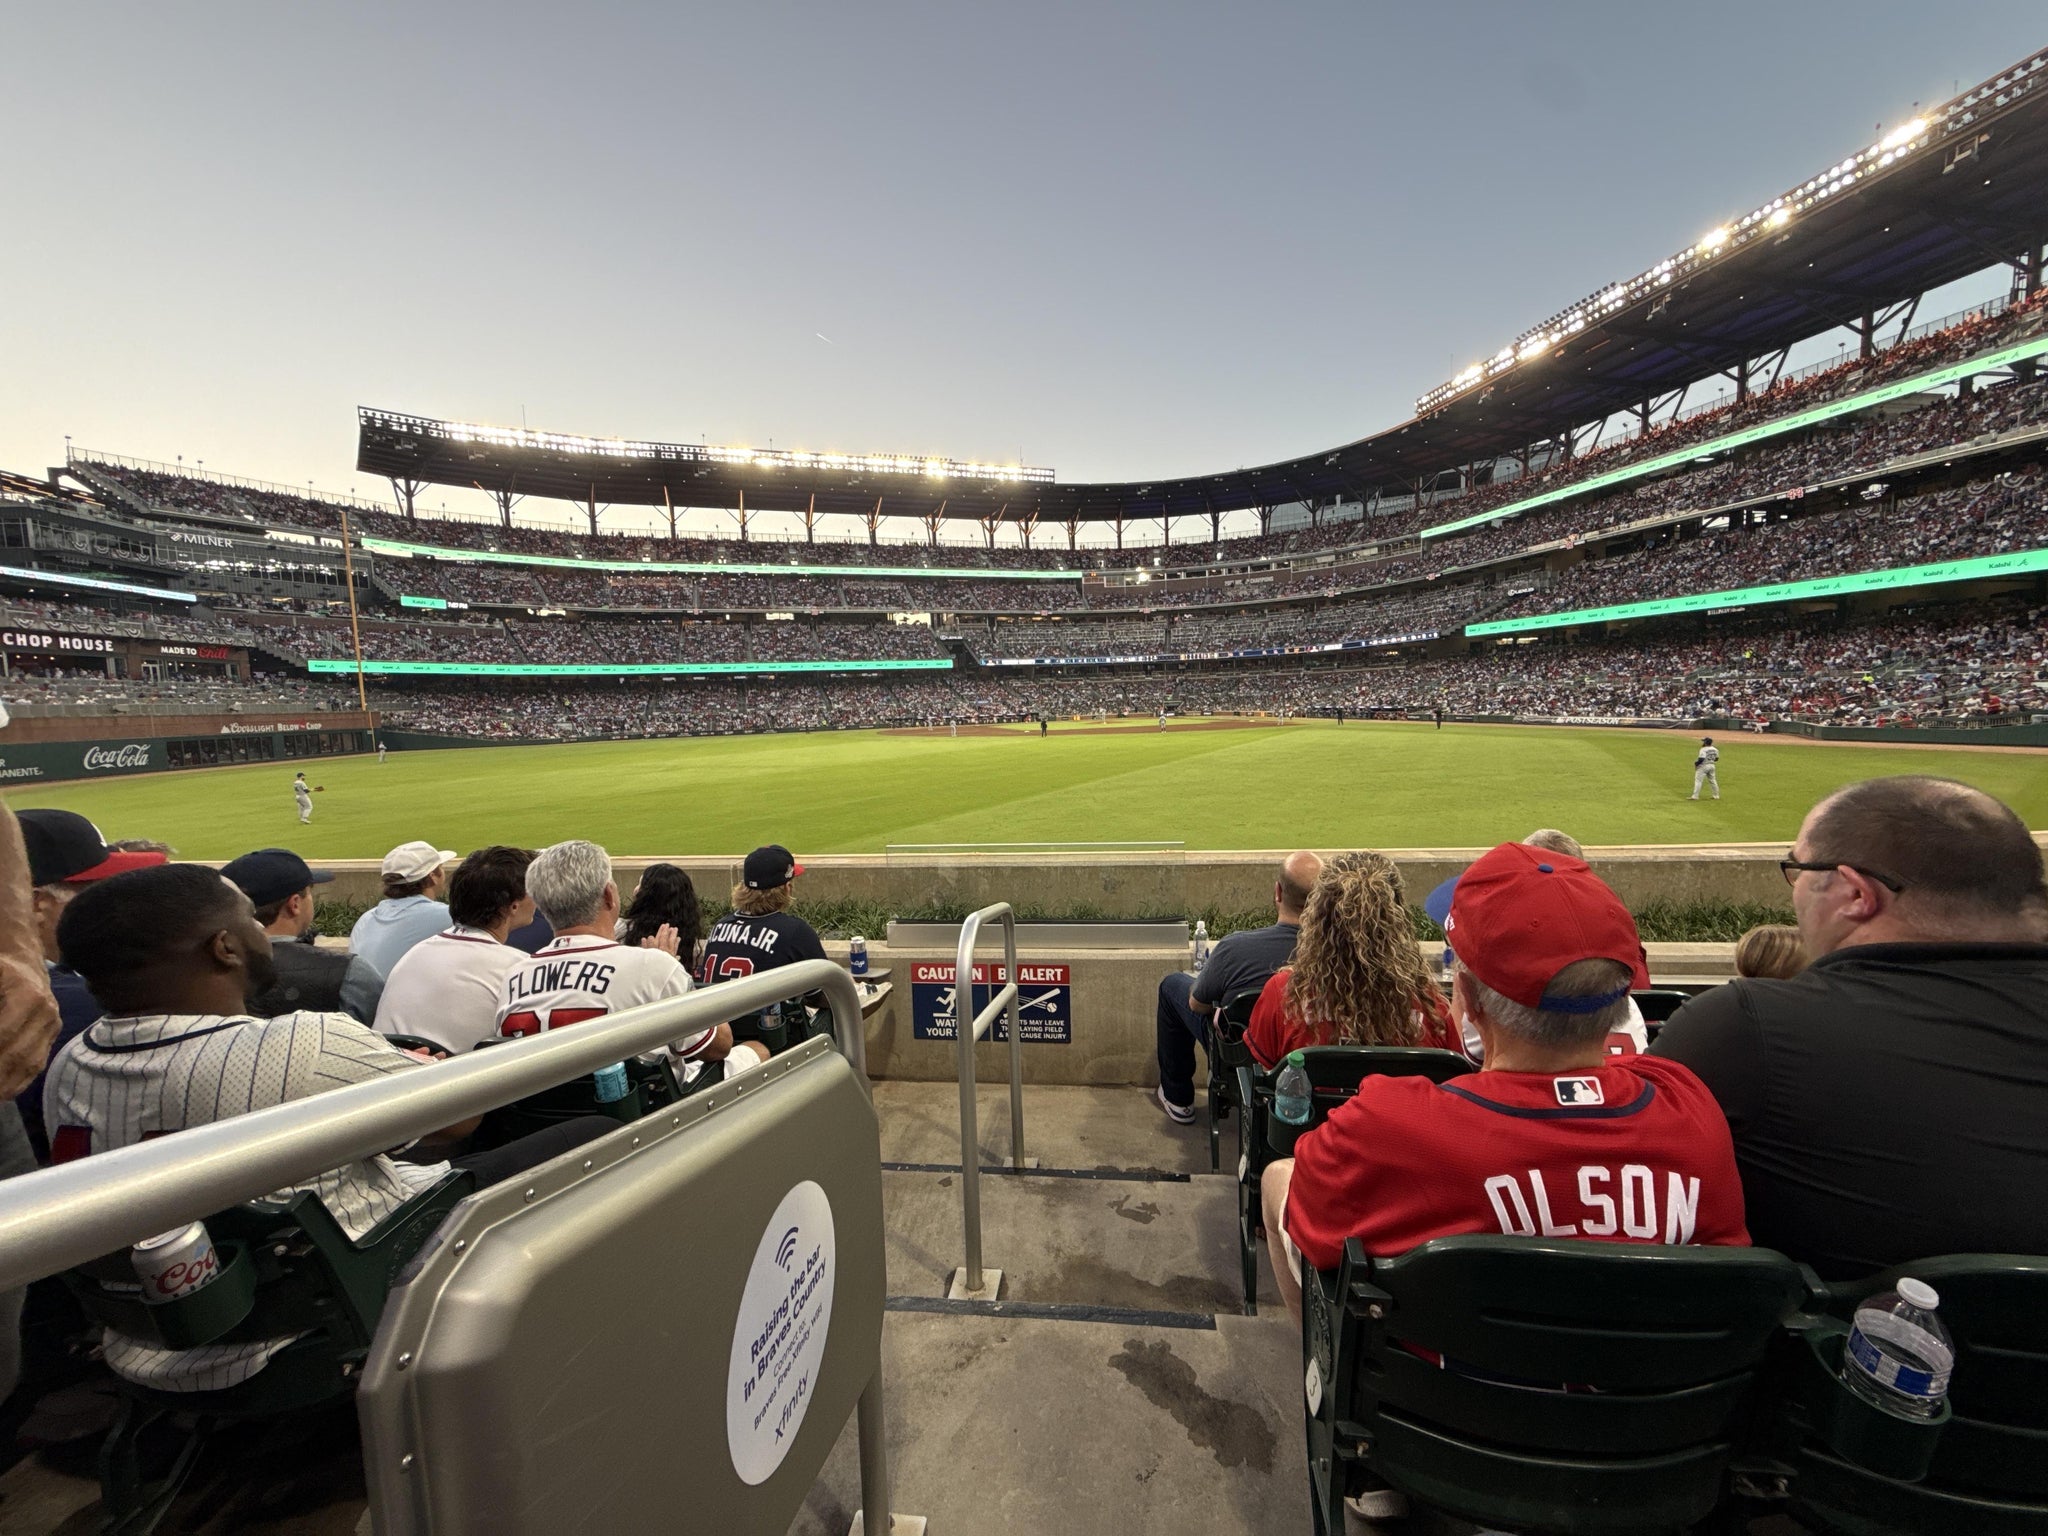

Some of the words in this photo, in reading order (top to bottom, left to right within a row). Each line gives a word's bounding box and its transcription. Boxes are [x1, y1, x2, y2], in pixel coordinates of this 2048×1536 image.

[184, 533, 234, 548] MILNER
[2, 632, 53, 648] CHOP
[59, 636, 114, 652] HOUSE
[160, 645, 185, 655] MADE
[186, 647, 197, 656] TO
[1566, 717, 1620, 725] POSTSEASON
[83, 744, 151, 770] Coca-Cola
[0, 767, 41, 778] ANENTE
[709, 920, 751, 945] CUÑA
[750, 927, 779, 954] JR.
[508, 960, 616, 1005] FLOWERS
[917, 967, 982, 981] CAUTN
[1020, 968, 1064, 982] ALERT
[925, 1027, 953, 1037] YOUR
[935, 1018, 959, 1028] WAT
[1484, 1164, 1700, 1245] OLSON
[751, 1296, 789, 1364] Raising
[790, 1270, 806, 1300] the
[806, 1244, 821, 1275] bar
[743, 1377, 755, 1403] in
[757, 1317, 792, 1380] Braves
[793, 1257, 826, 1320] Country
[773, 1331, 799, 1378] Connect
[754, 1386, 777, 1431] Braves
[778, 1361, 792, 1389] Free
[775, 1368, 809, 1446] xfinity
